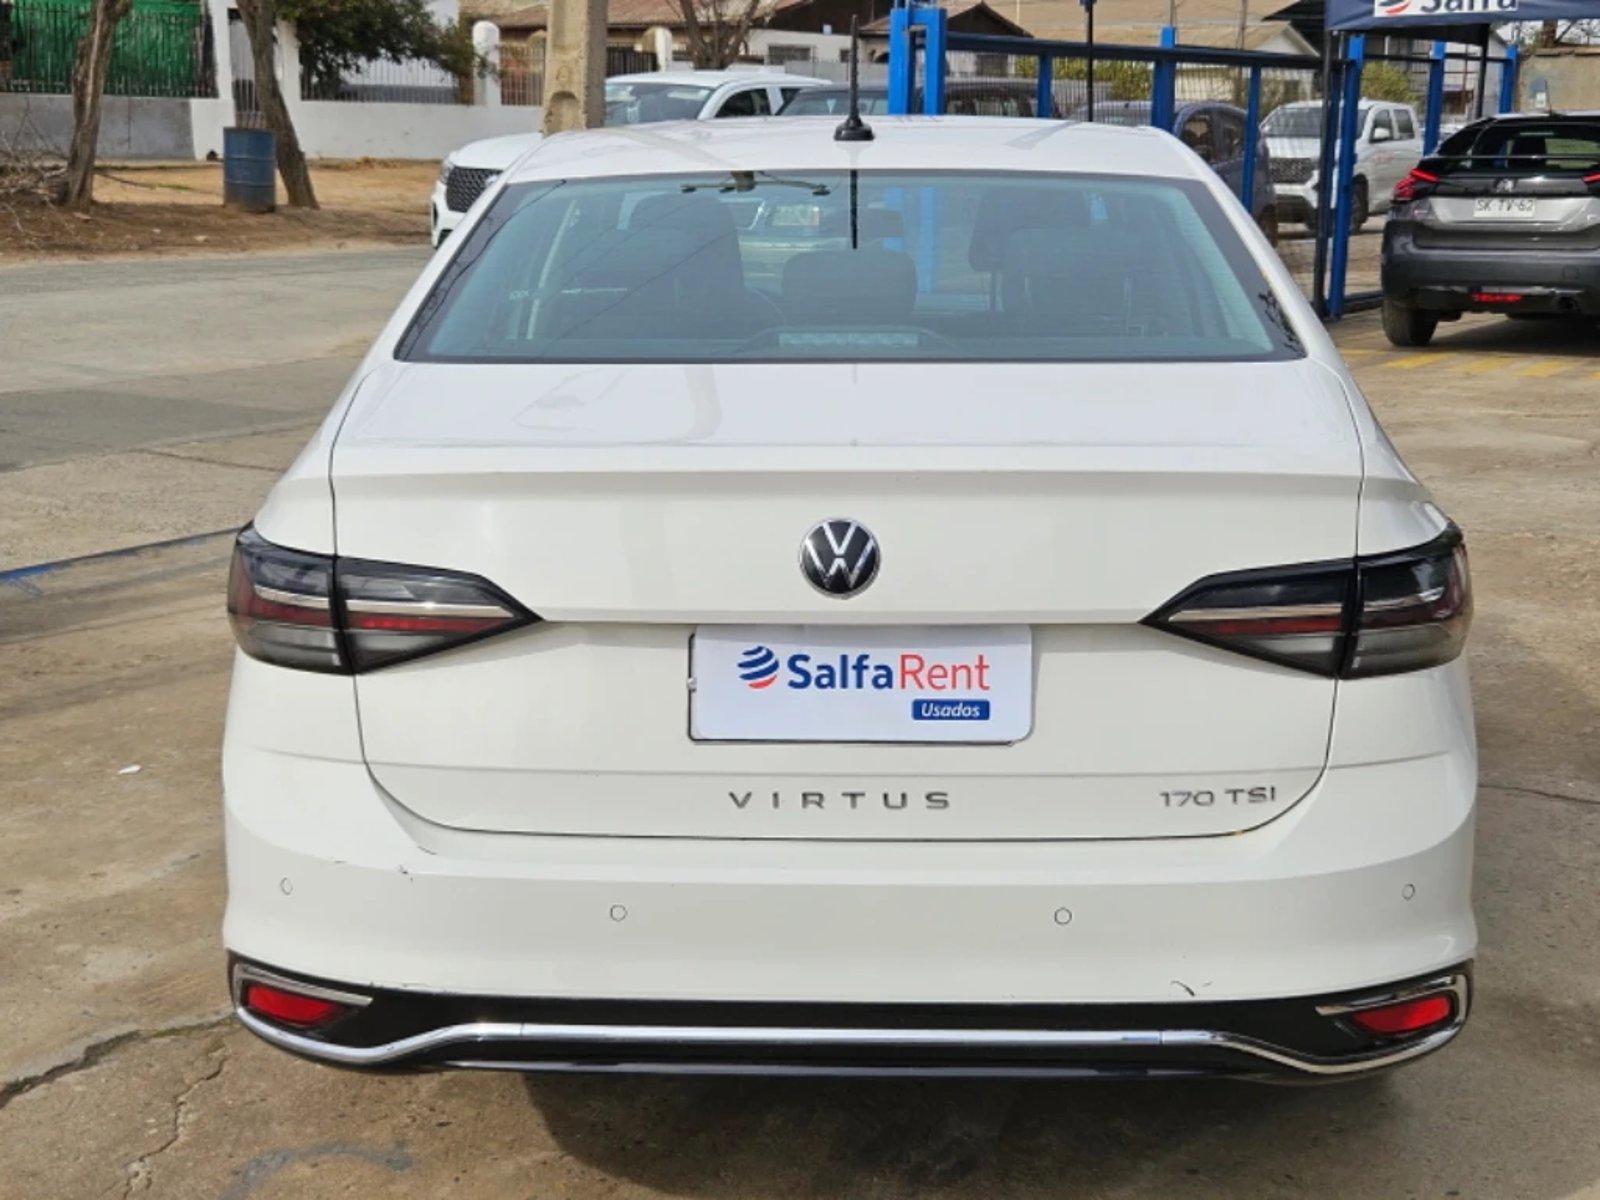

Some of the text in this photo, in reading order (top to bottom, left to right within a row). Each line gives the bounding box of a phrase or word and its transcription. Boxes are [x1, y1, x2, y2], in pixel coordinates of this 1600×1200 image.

[786, 653, 991, 691] SalfaRent
[920, 701, 981, 718] Usados
[728, 790, 950, 810] VIRTUS
[1160, 785, 1276, 807] 170 TSI
